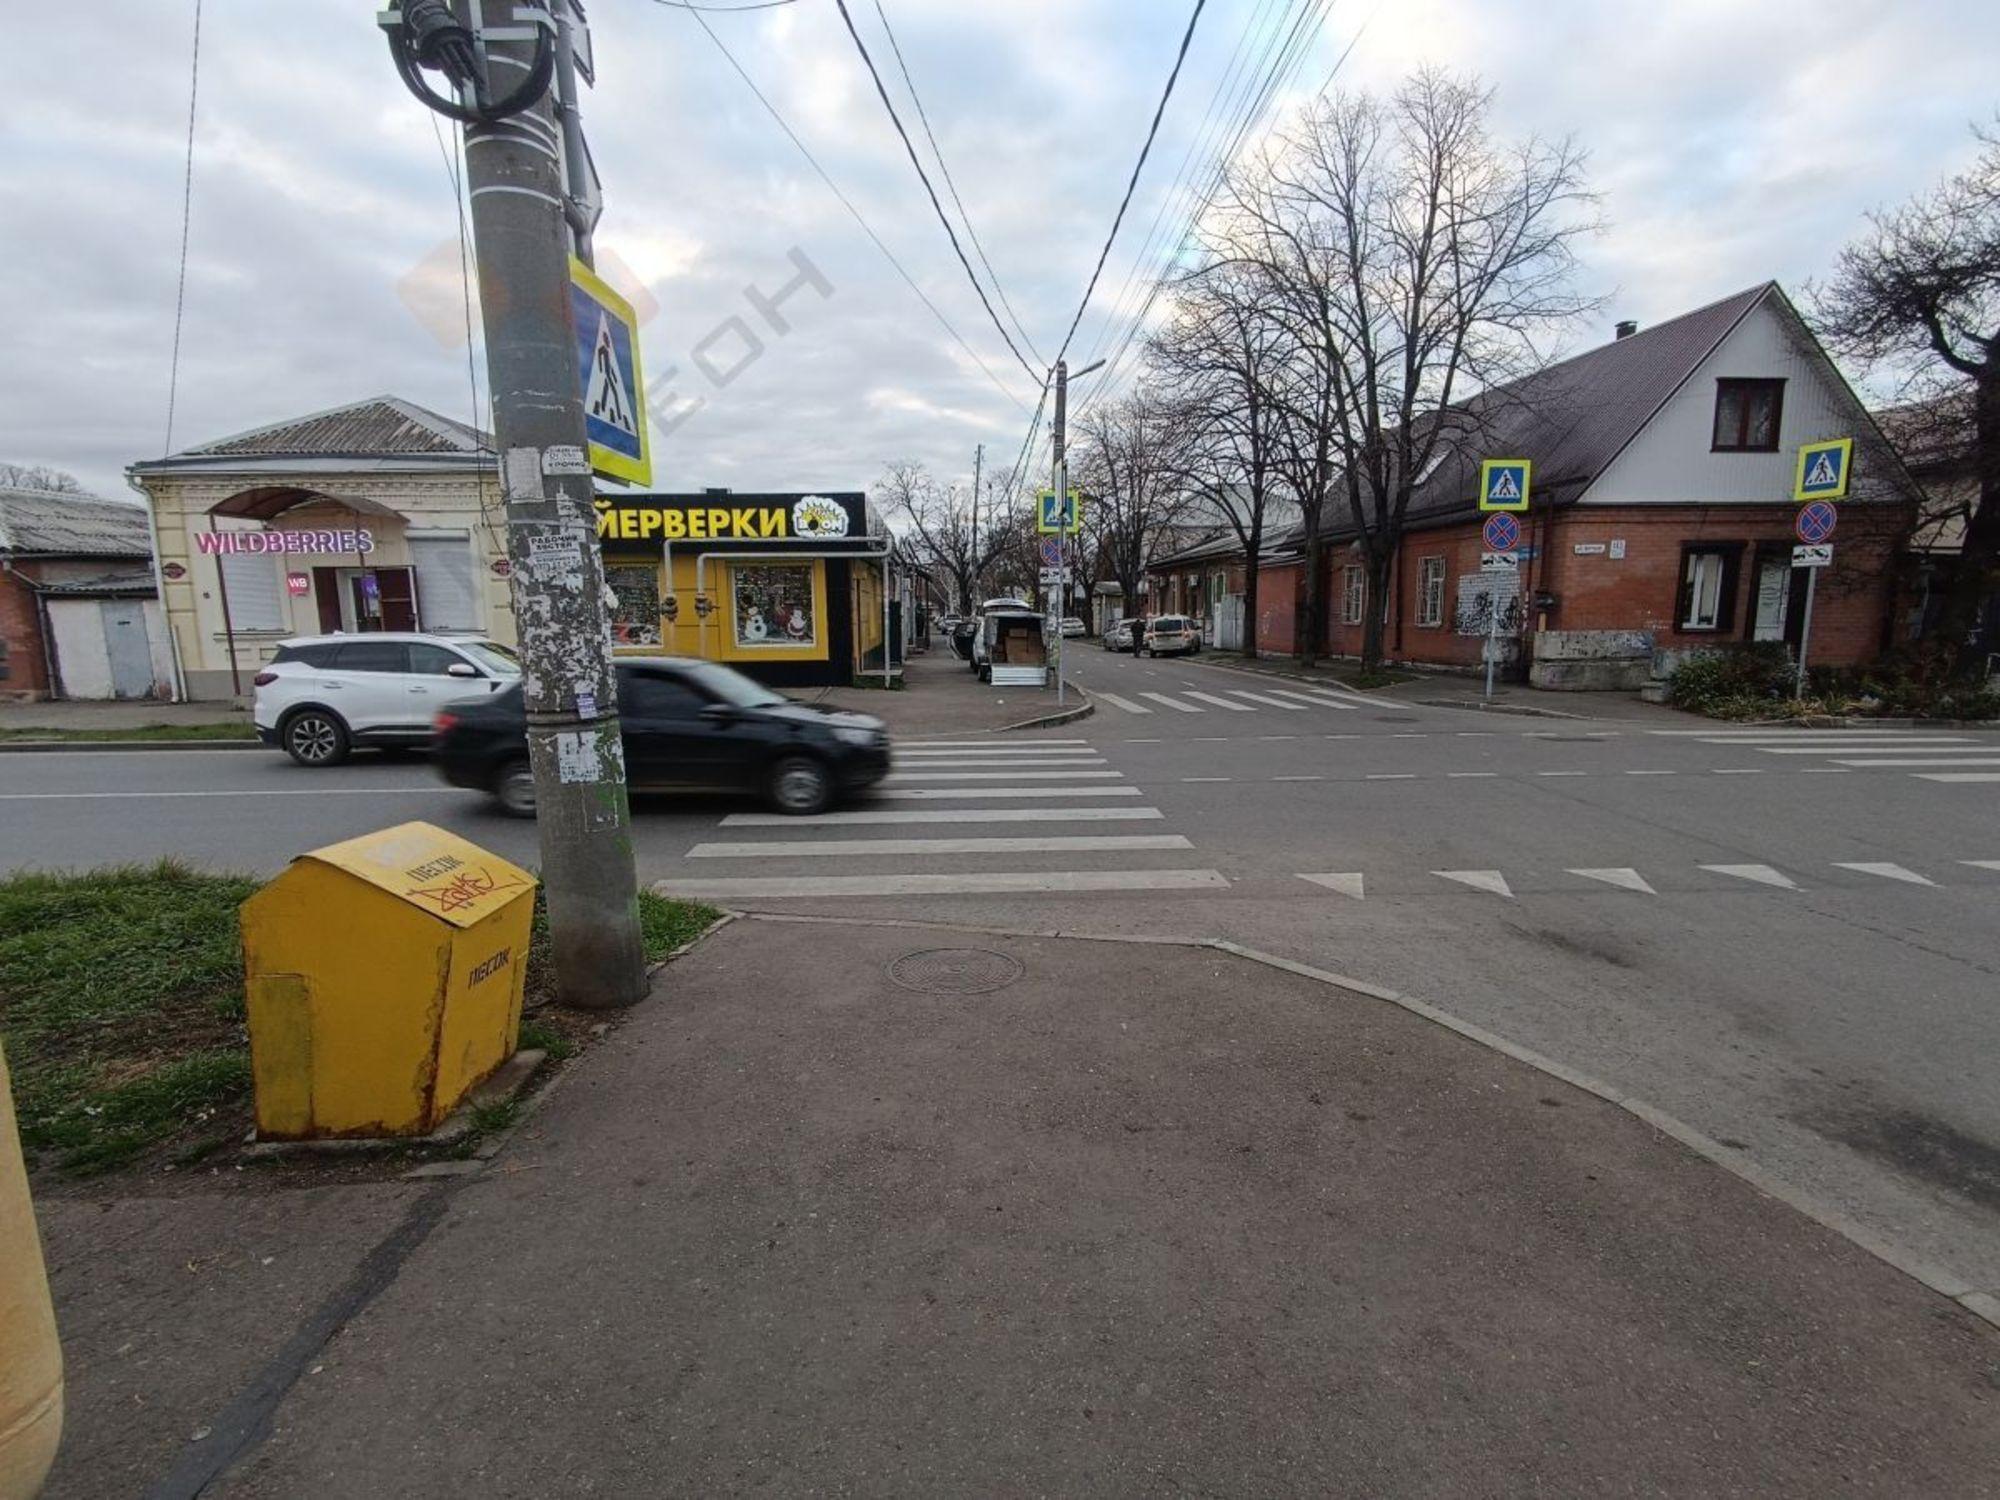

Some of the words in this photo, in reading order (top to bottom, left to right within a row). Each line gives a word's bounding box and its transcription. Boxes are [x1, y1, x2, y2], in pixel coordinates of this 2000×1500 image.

[195, 530, 374, 554] WILDBERRIES
[288, 577, 308, 588] WB
[467, 946, 512, 991] ПЕСОК
